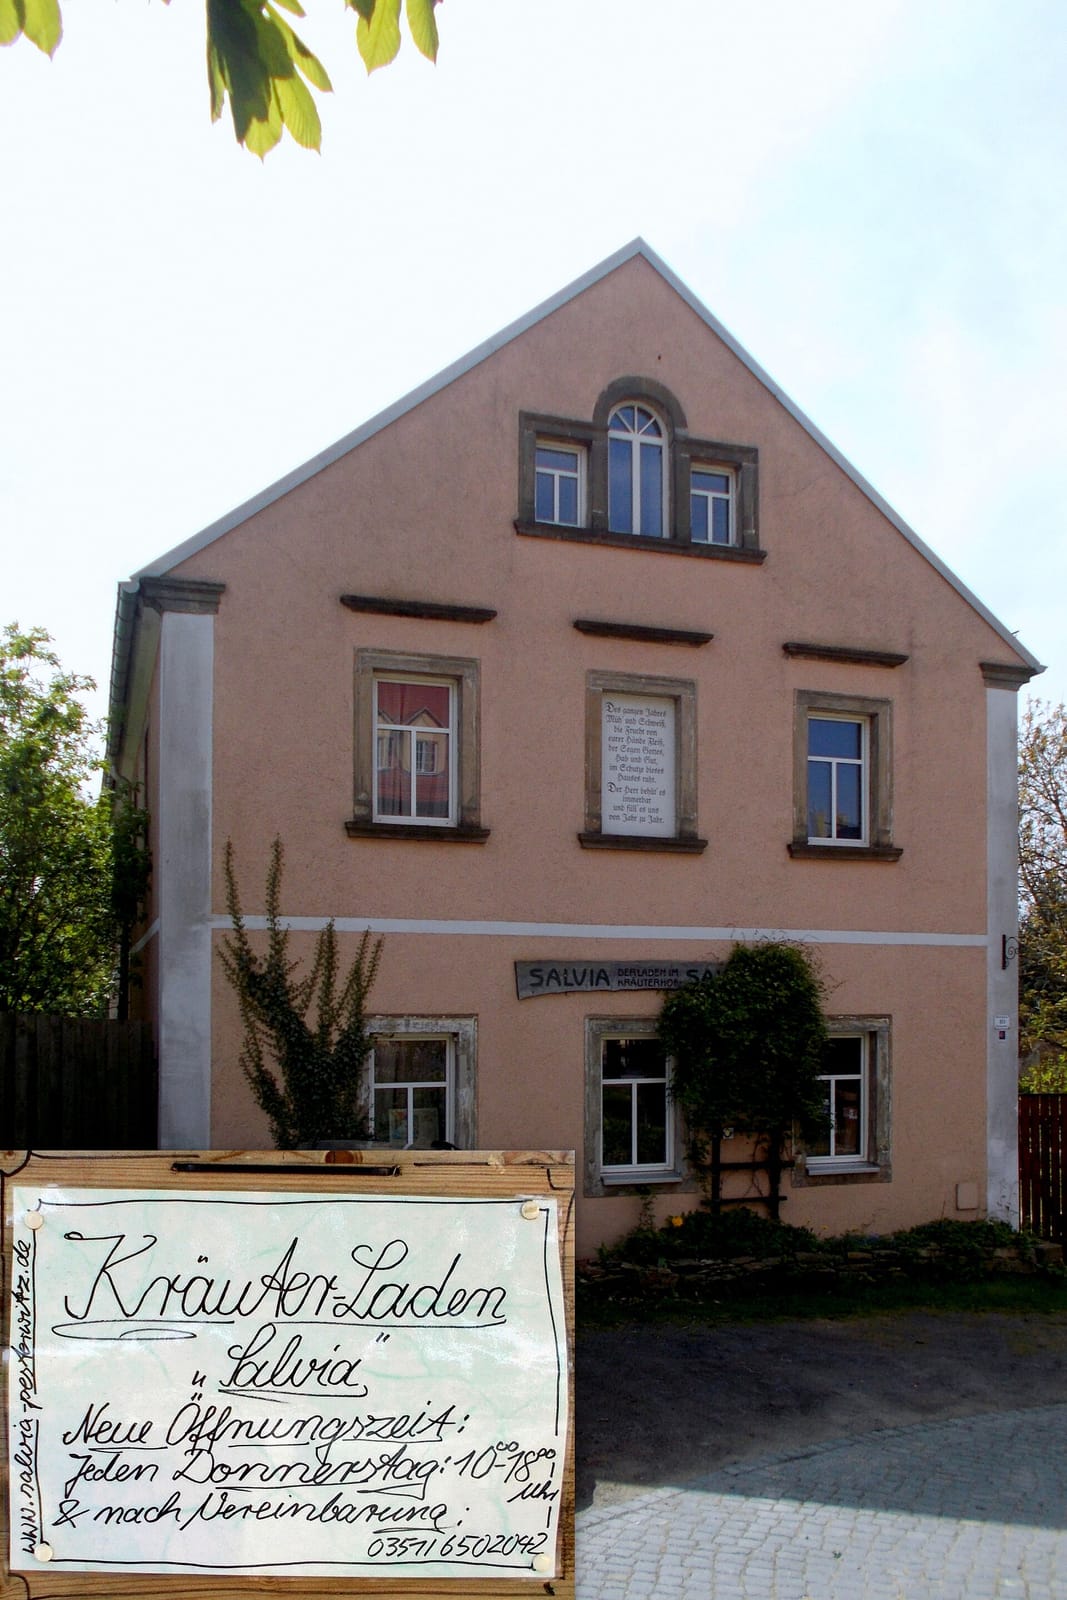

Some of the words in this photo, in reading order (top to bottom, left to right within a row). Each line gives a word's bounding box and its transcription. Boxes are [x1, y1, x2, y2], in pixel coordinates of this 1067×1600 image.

[645, 707, 666, 717] Jahres
[608, 782, 622, 792] Der
[622, 813, 637, 822] Jahr
[529, 968, 610, 987] SALVIA
[63, 1403, 149, 1445] Neue
[167, 1393, 469, 1460] Öffnungszeit:
[65, 1447, 161, 1499] Jeden
[172, 1444, 452, 1500] Donnerstag:
[52, 1499, 88, 1527] &
[93, 1491, 181, 1525] nach
